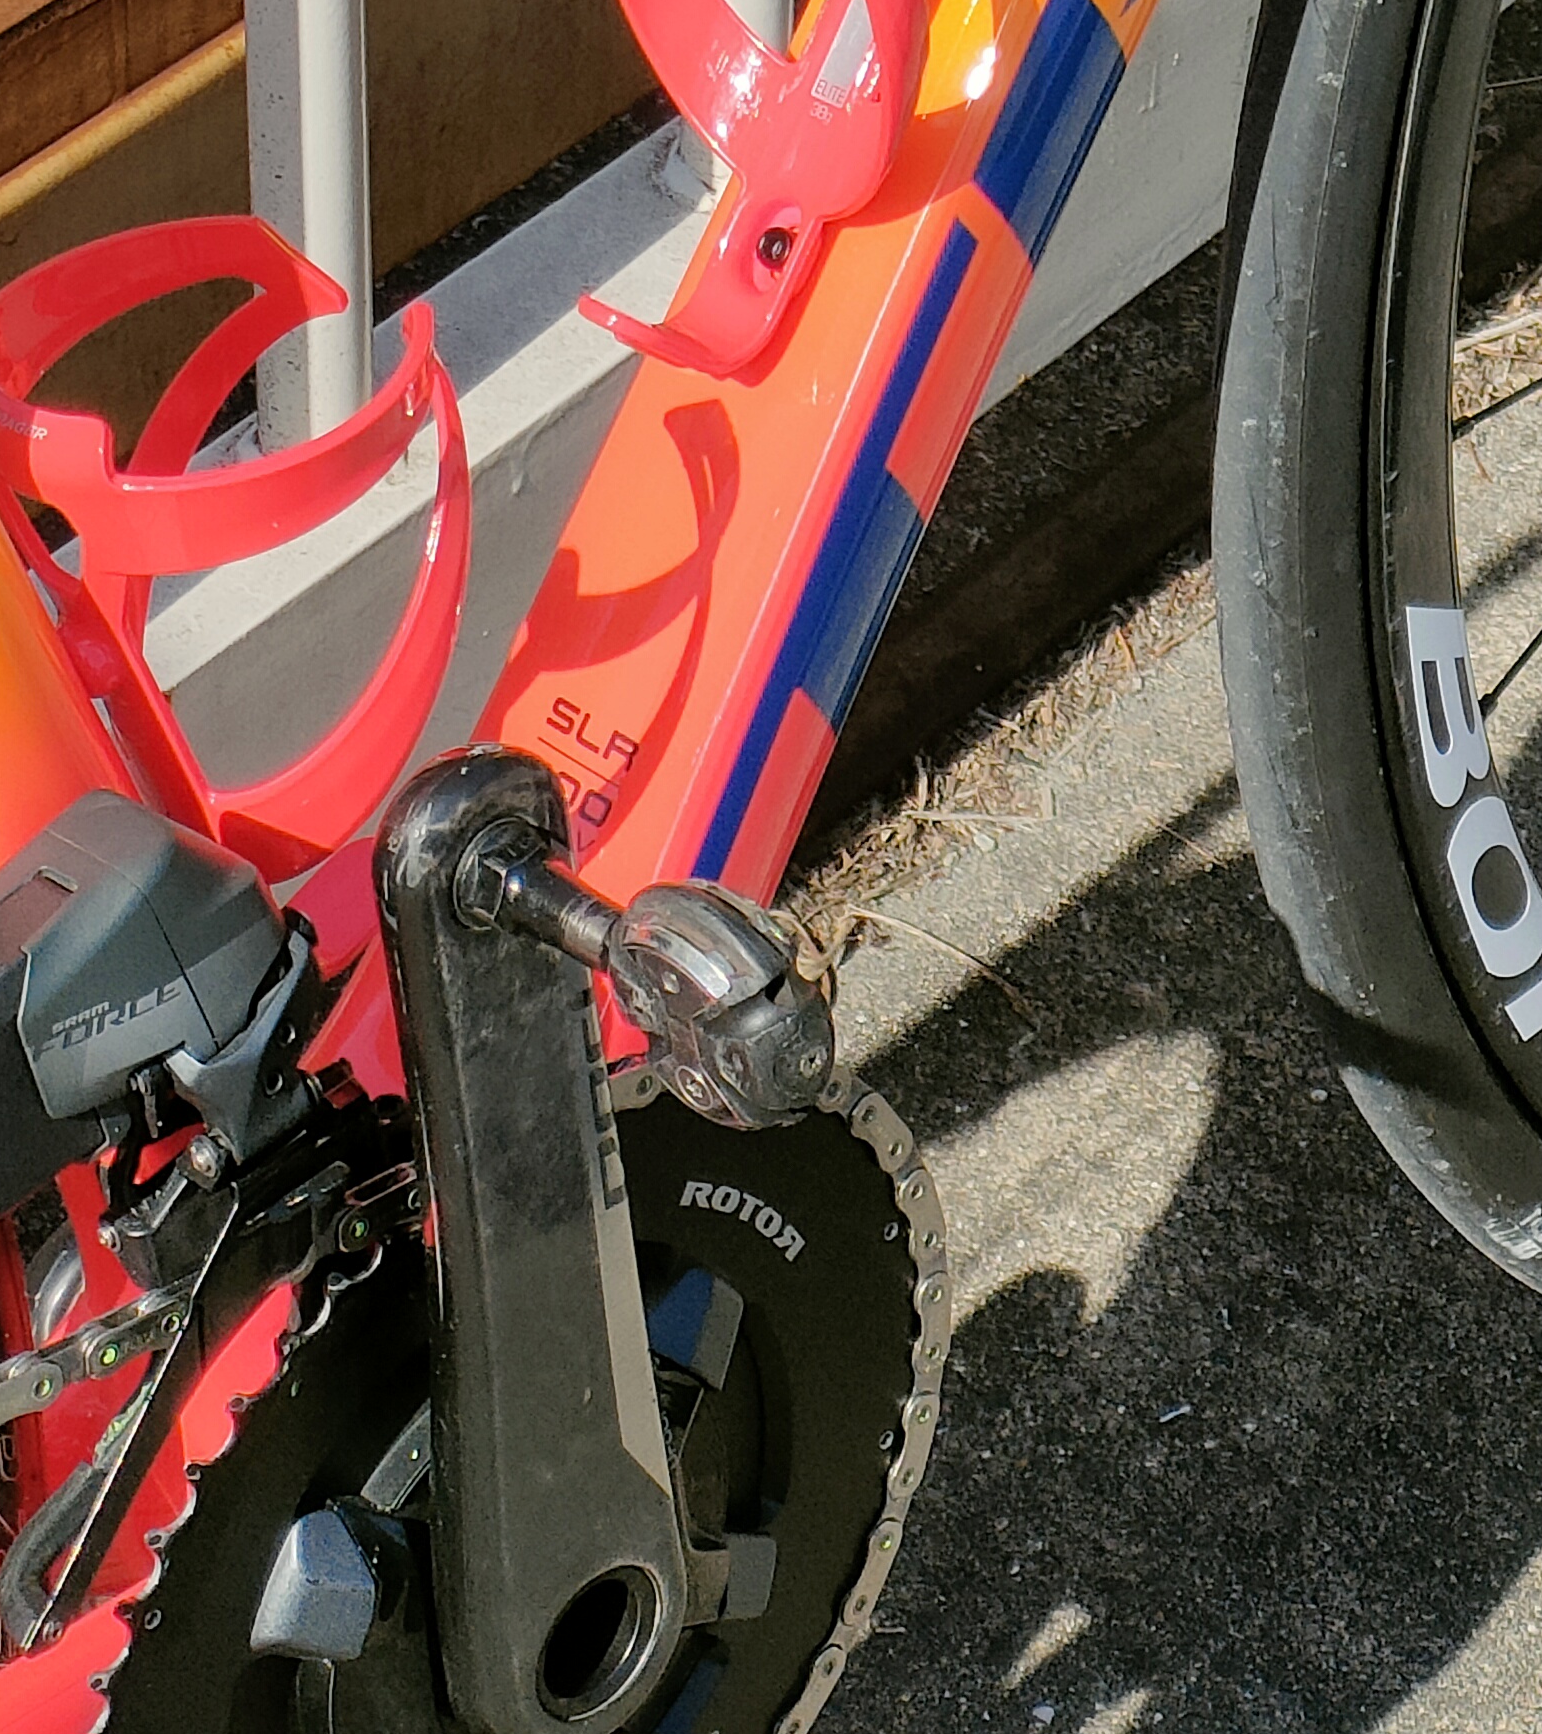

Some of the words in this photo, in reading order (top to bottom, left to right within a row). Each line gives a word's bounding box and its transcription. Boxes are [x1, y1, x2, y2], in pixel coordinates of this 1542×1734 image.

[814, 78, 847, 105] ELITE
[545, 696, 640, 772] SLR
[51, 1000, 110, 1036] SRAM
[678, 1179, 807, 1263] ROTOR
